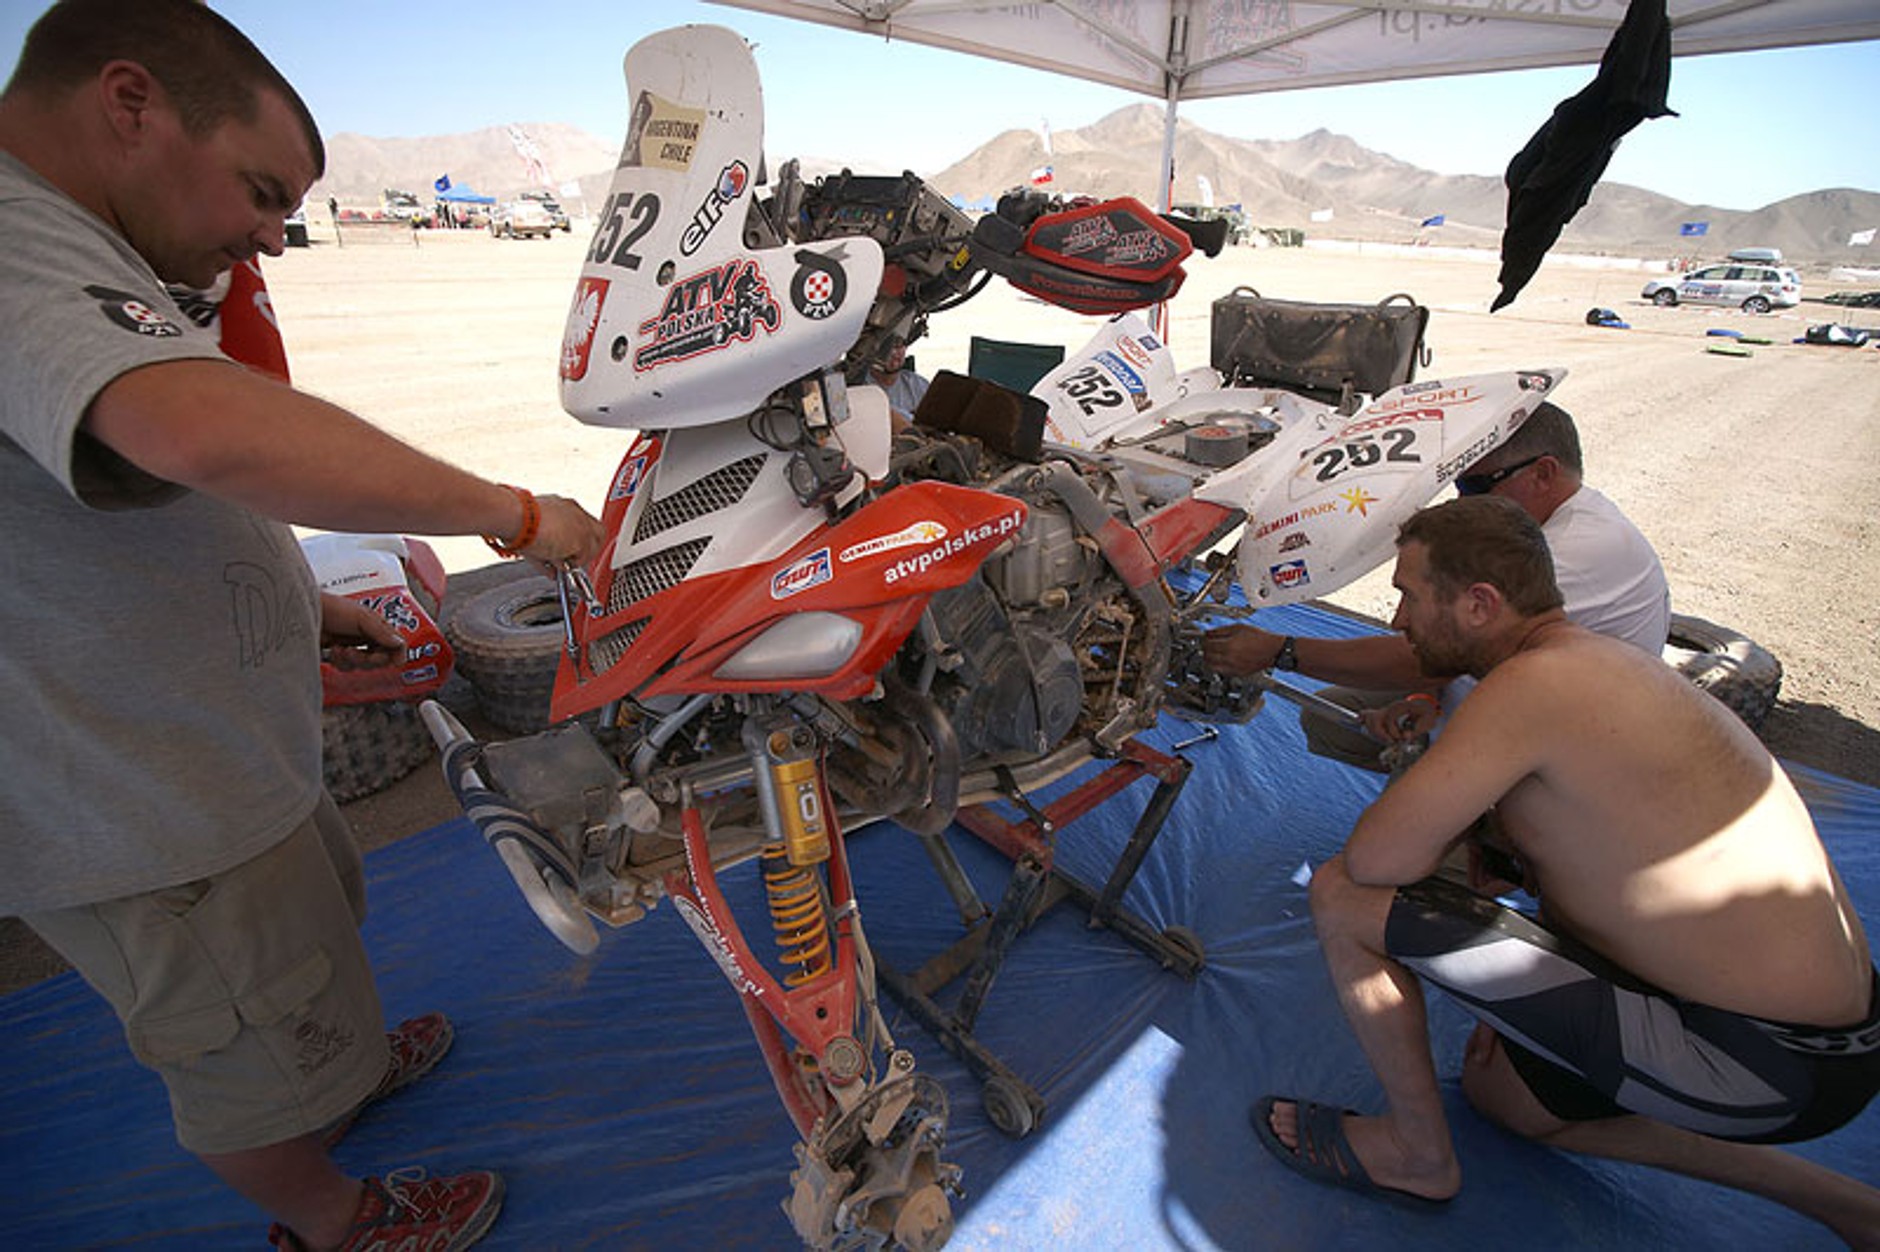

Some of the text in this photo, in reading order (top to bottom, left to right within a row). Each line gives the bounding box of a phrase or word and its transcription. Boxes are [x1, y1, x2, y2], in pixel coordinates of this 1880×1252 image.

[660, 142, 692, 163] CHILE
[662, 263, 738, 321] ATV
[803, 301, 835, 318] PZM
[657, 306, 715, 341] POLSKA
[1057, 366, 1124, 416] 252
[1313, 428, 1422, 481] 252
[1300, 502, 1338, 519] PARK
[884, 510, 1021, 584] atvpolska.pl
